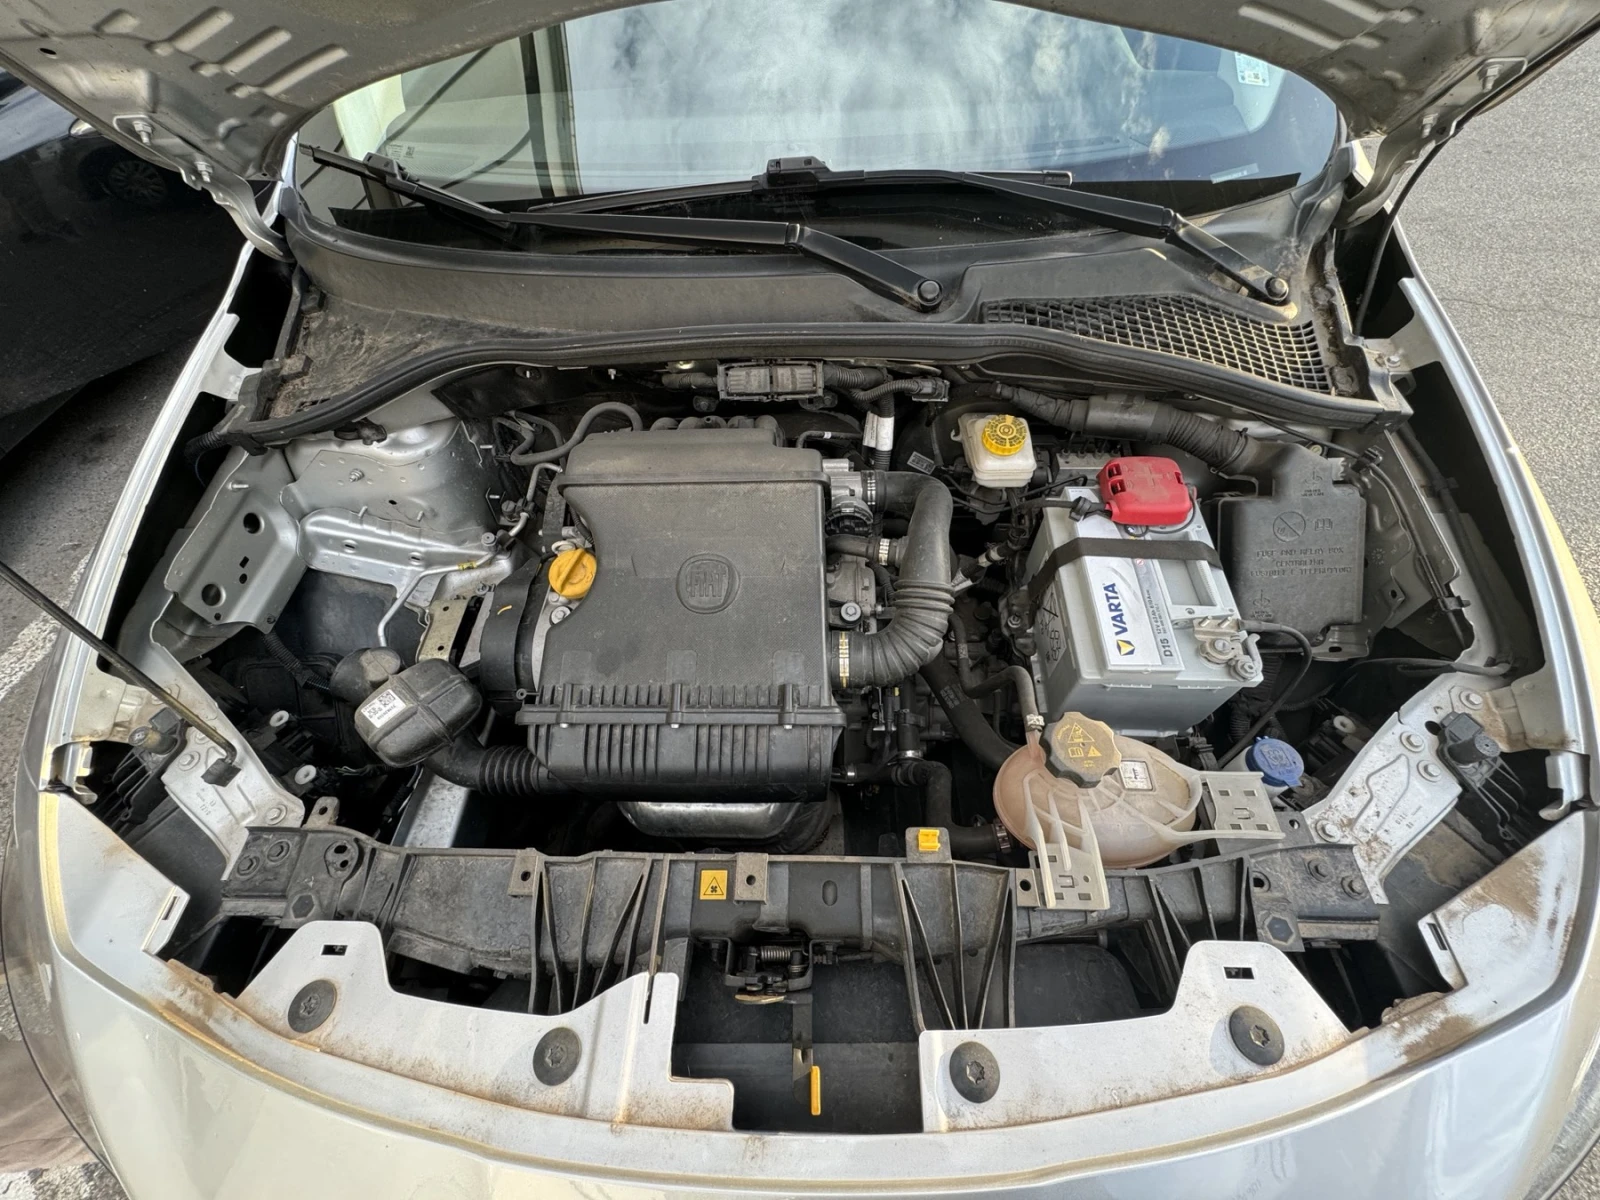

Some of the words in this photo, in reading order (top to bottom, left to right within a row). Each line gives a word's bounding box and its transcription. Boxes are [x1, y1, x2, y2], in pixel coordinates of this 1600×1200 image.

[690, 570, 727, 598] FIAT
[1103, 583, 1128, 636] VARTA
[1160, 638, 1174, 657] D15
